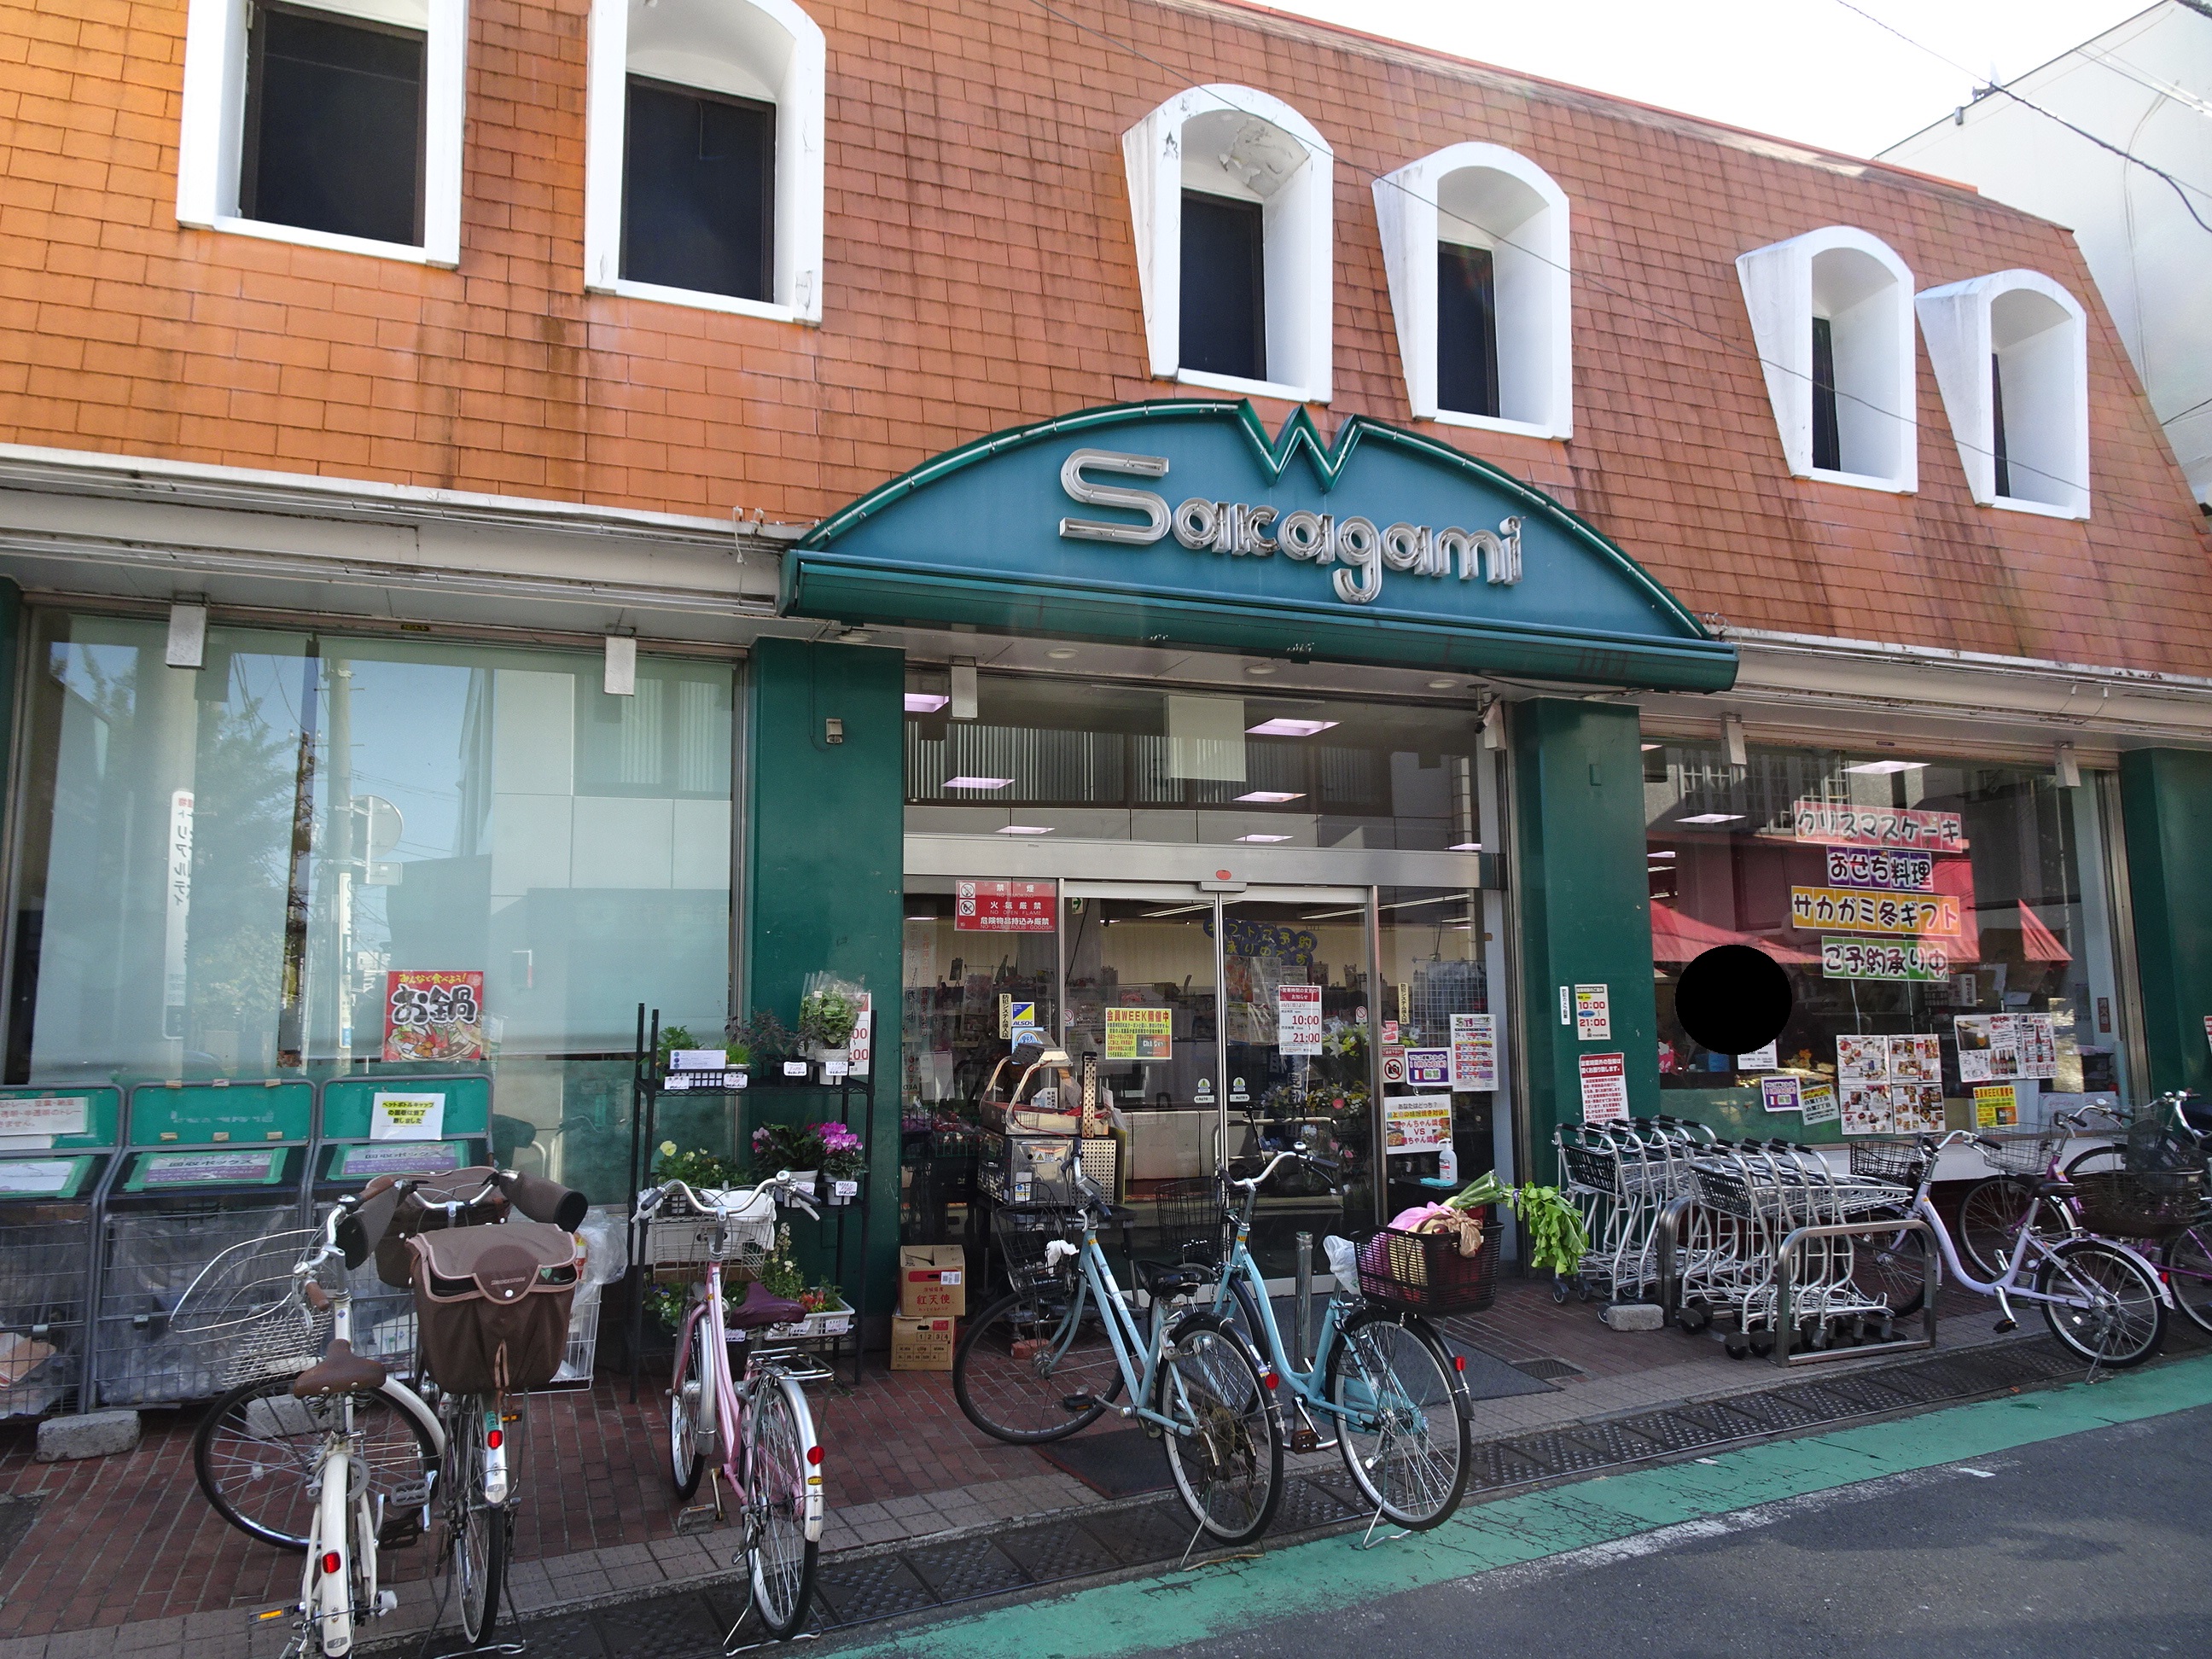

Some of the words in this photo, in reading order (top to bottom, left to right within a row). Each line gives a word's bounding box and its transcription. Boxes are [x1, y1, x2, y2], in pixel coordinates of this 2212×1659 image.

[1060, 448, 1524, 603] Sakagami
[1798, 811, 1959, 843] クリスマスケーキ
[1831, 853, 1931, 887] おせち料理
[996, 883, 1034, 893] 禁煙
[1794, 894, 1957, 928] サカガミ冬ギフト
[1825, 944, 1947, 976] ご予約承り中
[391, 983, 478, 1024] お鍋
[1578, 1001, 1605, 1010] 10:00
[1292, 1016, 1319, 1025] 10:00
[1579, 1018, 1606, 1027] 21:00
[1293, 1033, 1320, 1043] 21:00
[917, 1294, 951, 1305] 紅天使
